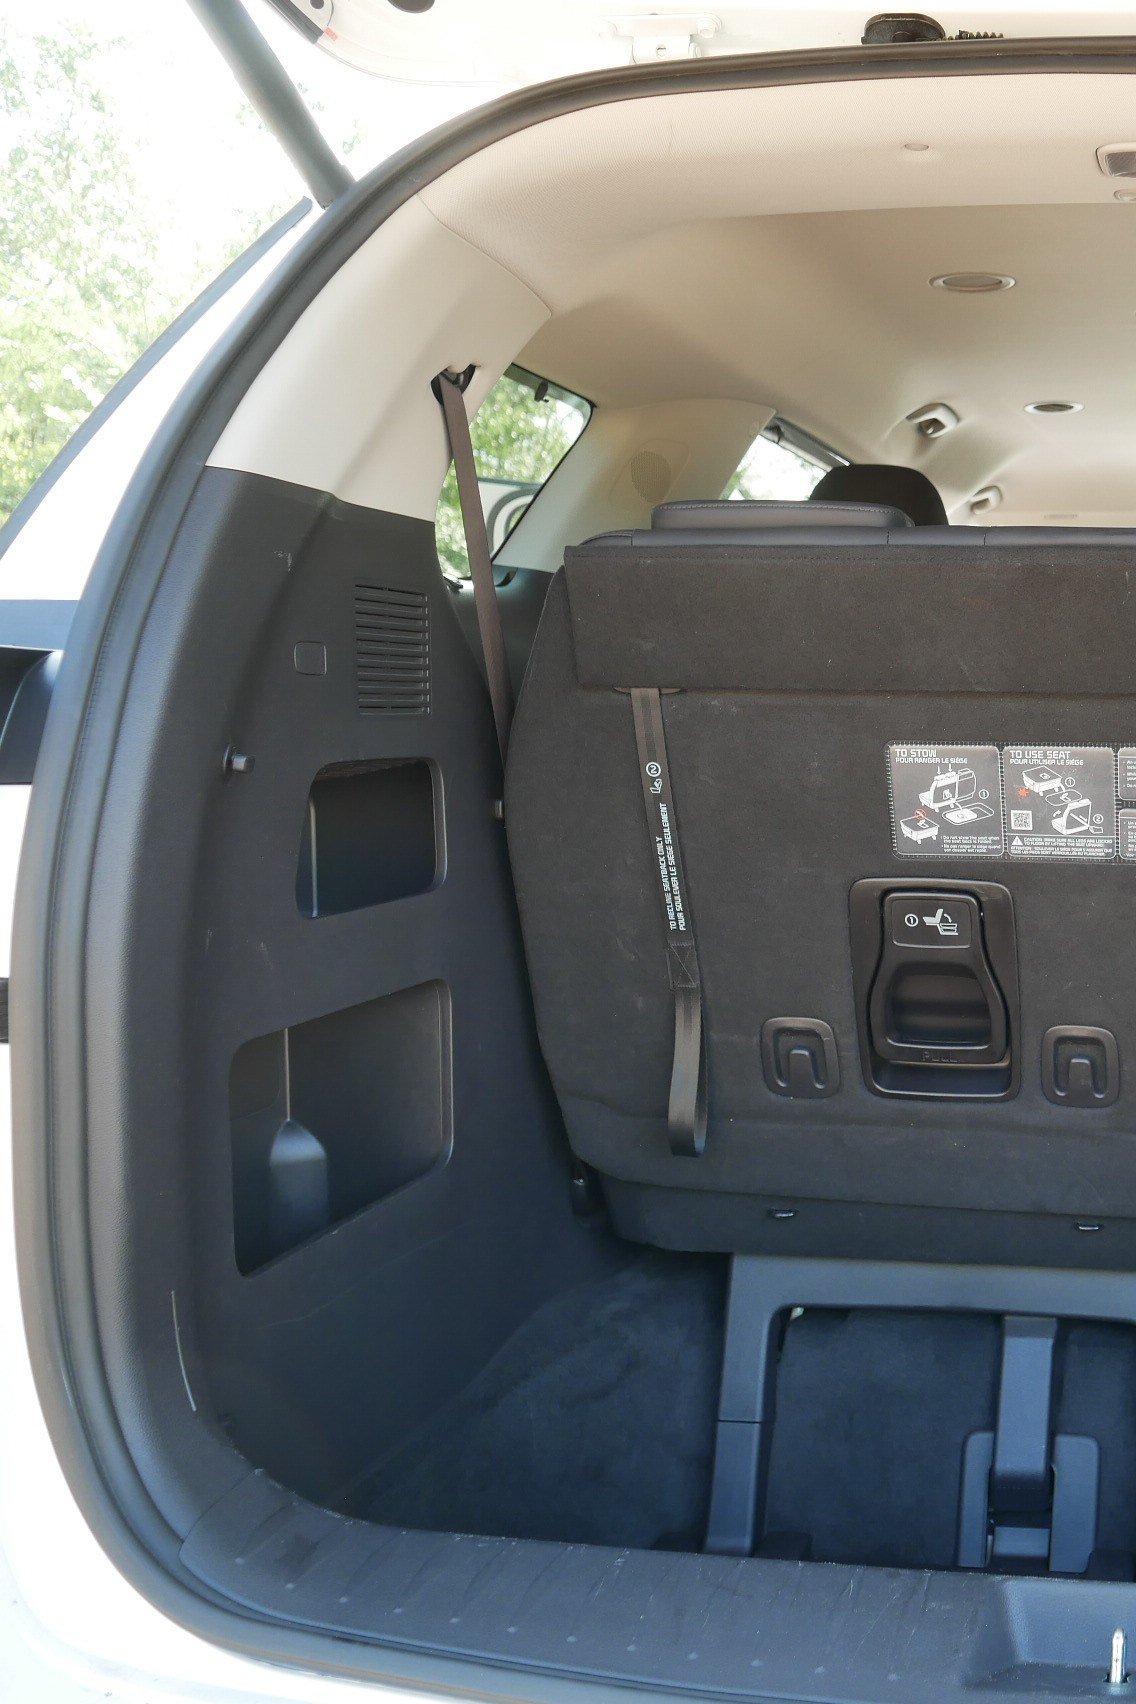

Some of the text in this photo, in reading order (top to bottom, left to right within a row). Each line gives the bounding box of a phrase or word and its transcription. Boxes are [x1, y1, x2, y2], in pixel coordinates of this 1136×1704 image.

[894, 749, 936, 758] TO STOW
[1046, 751, 1070, 759] SEAT
[660, 803, 672, 844] SEULEMENT
[669, 866, 676, 876] LE
[656, 836, 677, 930] TO RECLINE SEATBACK ONLY
[671, 877, 683, 911] SOULEVER
[677, 912, 686, 930] POUR
